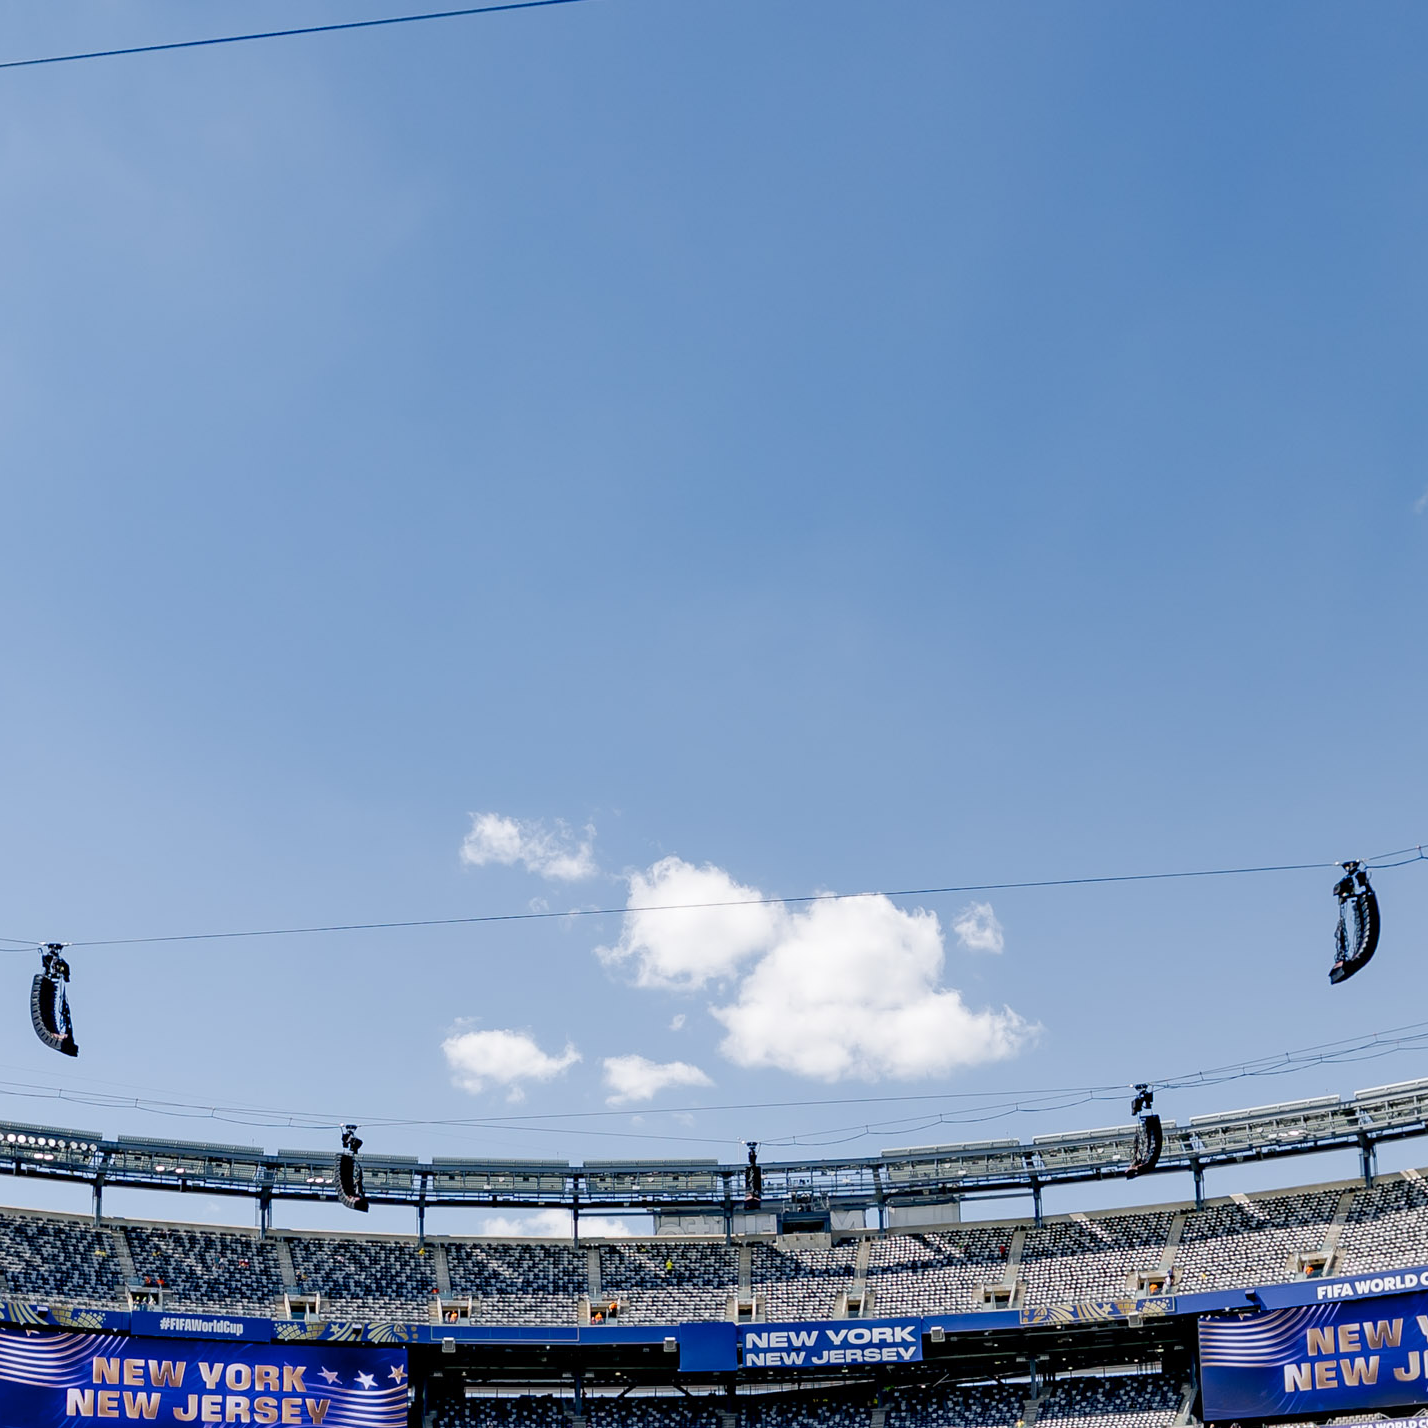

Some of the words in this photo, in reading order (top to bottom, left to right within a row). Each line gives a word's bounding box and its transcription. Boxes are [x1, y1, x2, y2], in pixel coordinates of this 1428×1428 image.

[1316, 1283, 1354, 1300] FIFA
[1354, 1273, 1418, 1295] WORLD
[159, 1316, 244, 1336] #FIFAWorldCup
[745, 1330, 819, 1349] NEW
[825, 1325, 917, 1346] YORK
[1306, 1318, 1404, 1356] NEW
[745, 1351, 806, 1367] NEW
[812, 1346, 917, 1365] JERSEY
[92, 1356, 186, 1387] NEW
[198, 1361, 308, 1392] YORK
[1283, 1355, 1380, 1393] NEW
[66, 1388, 162, 1420] NEW
[173, 1394, 332, 1425] JERSEY
